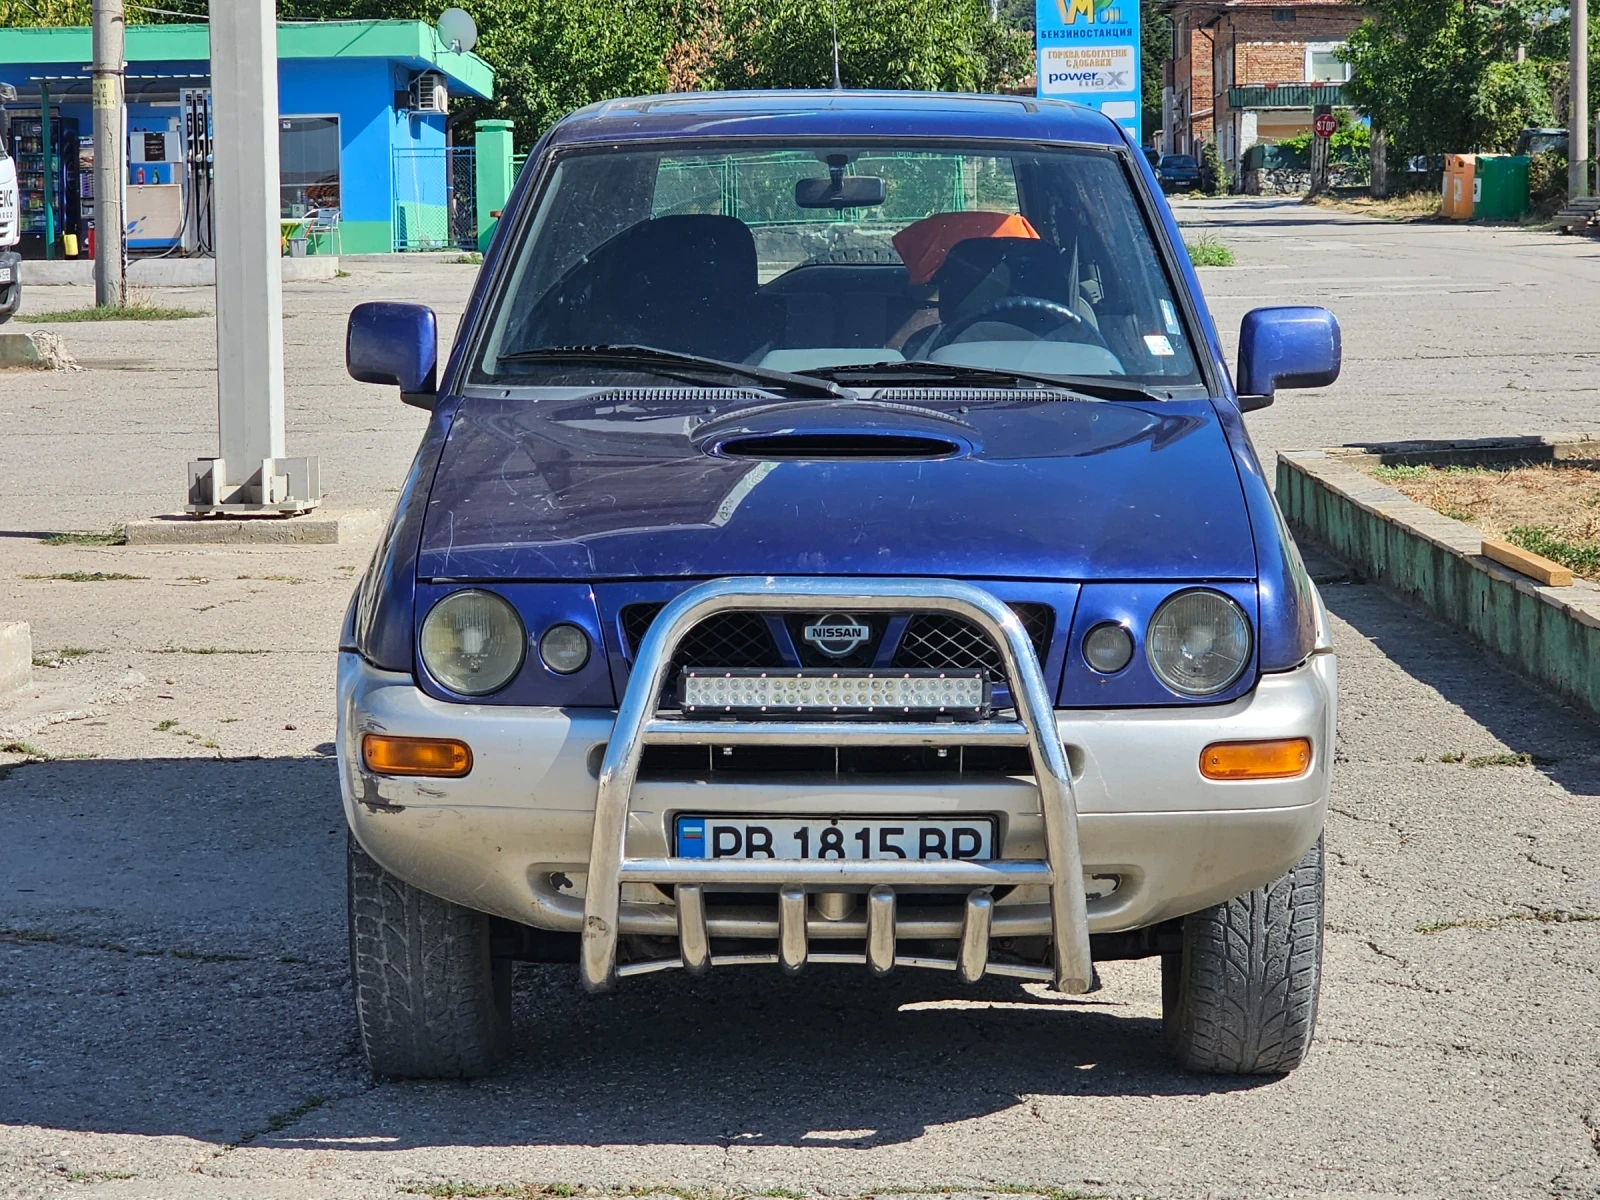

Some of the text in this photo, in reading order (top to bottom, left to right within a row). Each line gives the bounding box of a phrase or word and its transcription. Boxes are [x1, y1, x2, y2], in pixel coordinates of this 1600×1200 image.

[1041, 28, 1133, 38] БЕНЗИНОСТАНЦИЯ
[1048, 49, 1127, 59] ГОРИВА ОБОГАТЕНИ
[1073, 59, 1112, 69] ДОБАВКИ
[1049, 72, 1098, 84] power
[1317, 120, 1335, 131] STOP
[812, 628, 861, 638] NISSAN
[793, 827, 906, 859] 1815
[919, 828, 982, 859] BP
